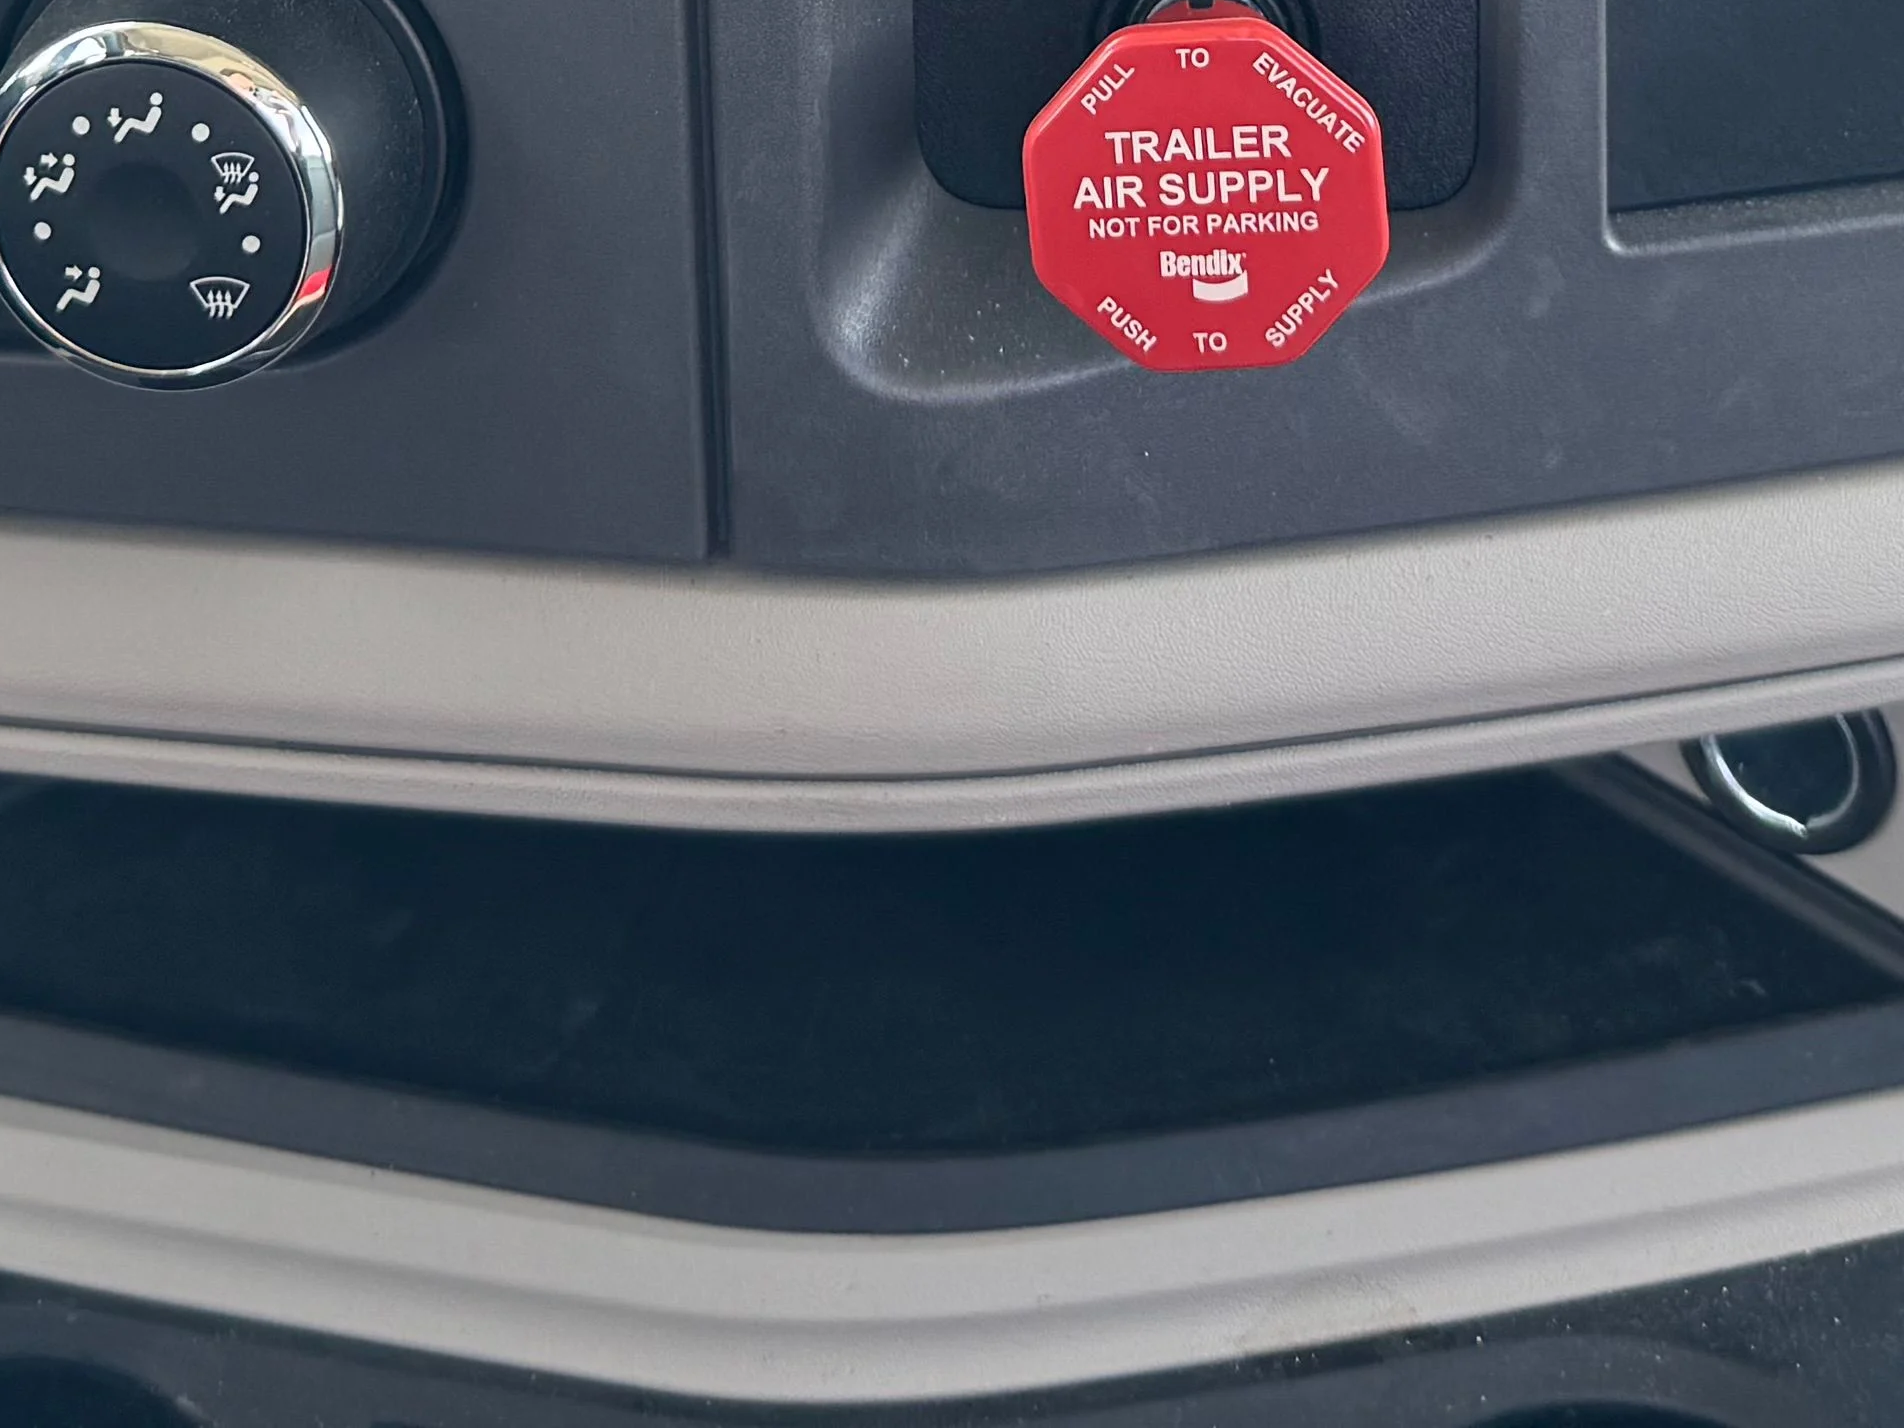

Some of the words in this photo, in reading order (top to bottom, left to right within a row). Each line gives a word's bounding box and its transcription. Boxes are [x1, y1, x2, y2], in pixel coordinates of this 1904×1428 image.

[1080, 63, 1135, 115] PULL
[1176, 48, 1210, 69] TO
[1252, 52, 1365, 154] EVACUATE
[1104, 125, 1292, 164] TRAILER
[1073, 175, 1147, 210] AIR
[1158, 168, 1330, 206] SUPPLY
[1089, 216, 1140, 239] NOT
[1147, 214, 1200, 237] FOR
[1206, 210, 1319, 234] PARKING
[1159, 249, 1243, 277] Bendix
[1096, 296, 1157, 353] PUSH
[1192, 332, 1228, 353] TO
[1264, 268, 1340, 349] SUPPLY
